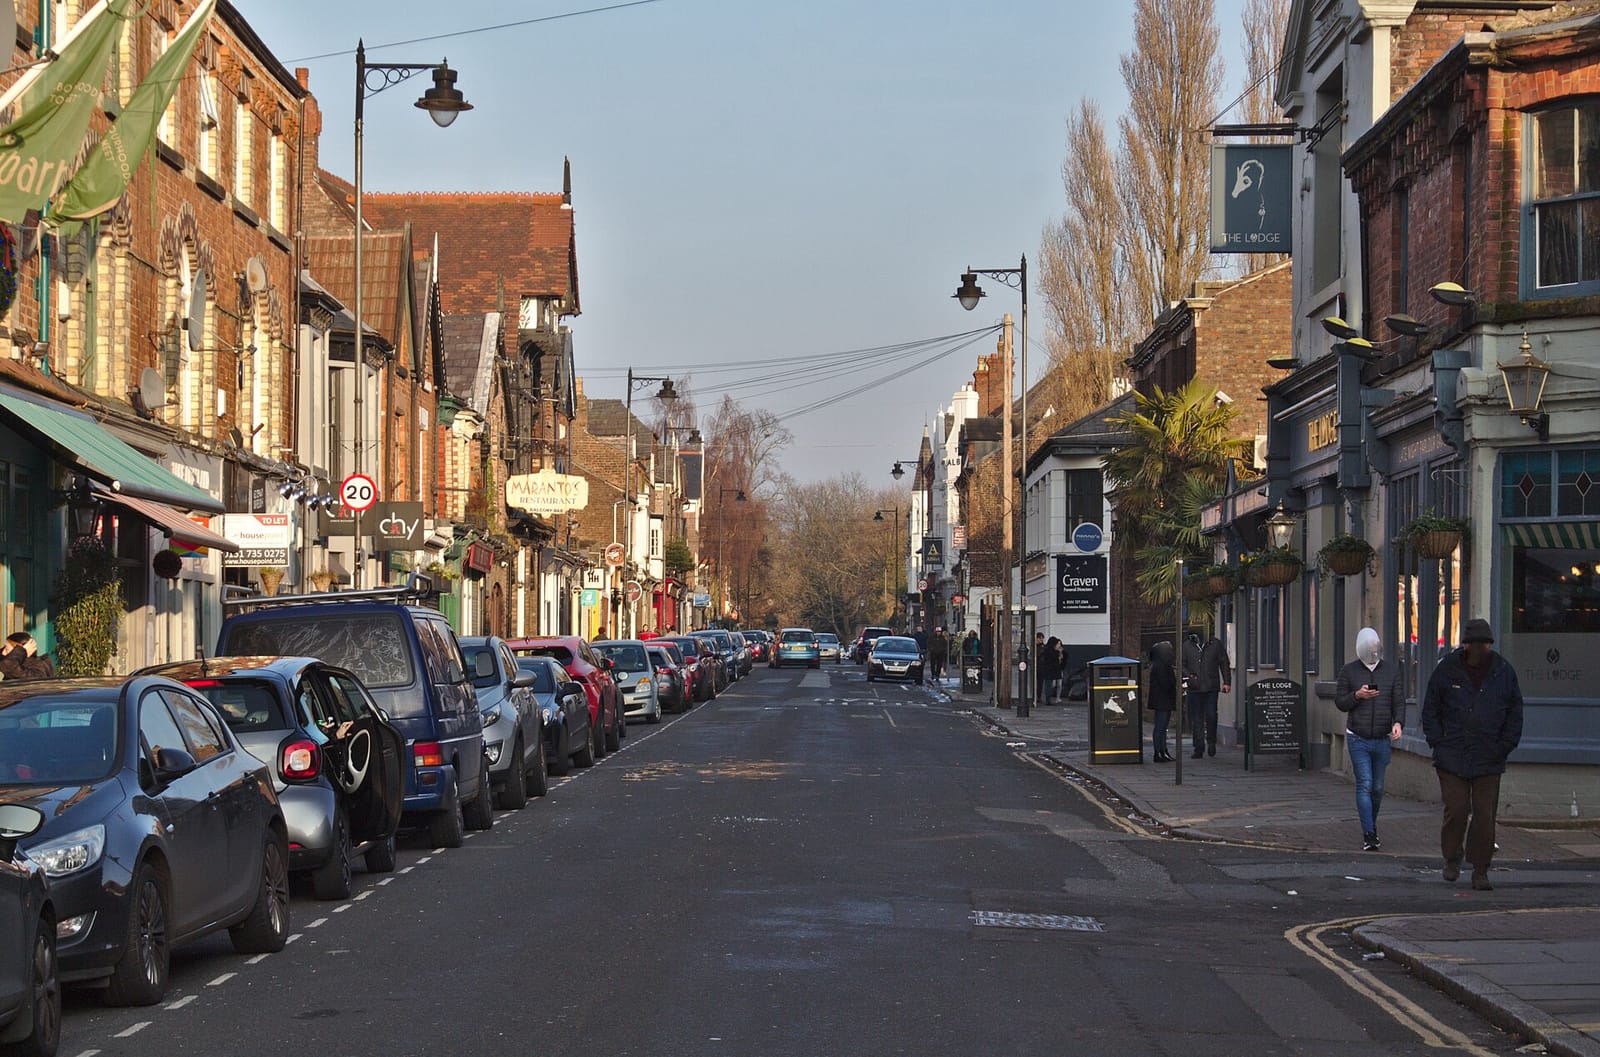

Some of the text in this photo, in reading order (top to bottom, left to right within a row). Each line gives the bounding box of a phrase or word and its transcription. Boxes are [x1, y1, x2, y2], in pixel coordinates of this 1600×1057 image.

[1222, 232, 1281, 243] THE LODGE
[346, 485, 371, 500] 20
[520, 496, 577, 505] RESTAURANT
[262, 517, 286, 525] TO LET
[246, 549, 262, 558] 735
[263, 549, 286, 558] 0275
[1062, 574, 1099, 587] Craven
